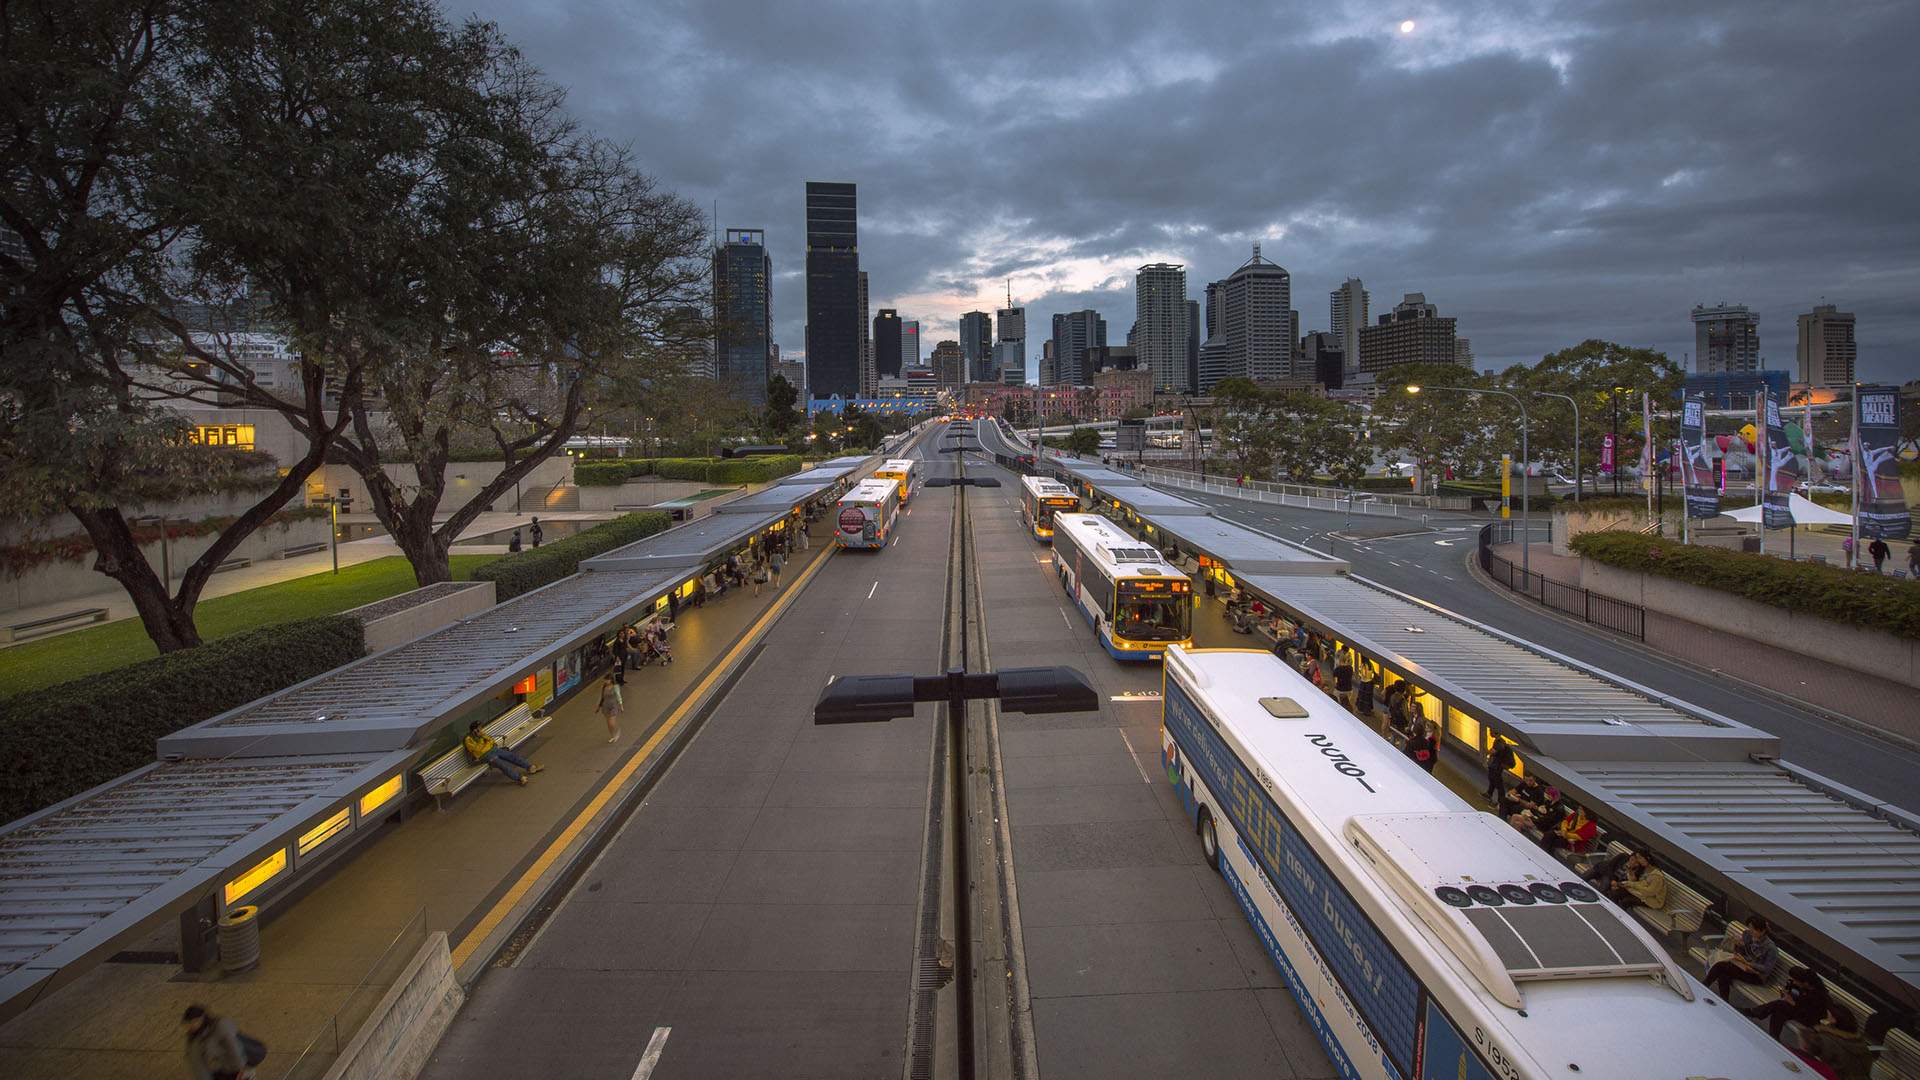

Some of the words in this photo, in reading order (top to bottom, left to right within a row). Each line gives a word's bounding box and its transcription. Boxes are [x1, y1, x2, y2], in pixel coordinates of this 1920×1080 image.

[1861, 402, 1894, 416] BALLET
[1862, 394, 1895, 403] AMERICAN
[1862, 412, 1895, 424] THEATRE
[1304, 734, 1376, 793] 1952
[1192, 725, 1228, 789] delivered
[1232, 767, 1281, 876] 500
[1286, 850, 1316, 896] new
[1324, 888, 1383, 997] buses!
[1257, 919, 1275, 950] more
[1275, 949, 1324, 1035] comfortable,
[1326, 1031, 1351, 1077] more
[1304, 941, 1319, 965] new
[1320, 960, 1333, 988] bus
[1335, 985, 1354, 1019] since
[1356, 1015, 1378, 1055] 2008
